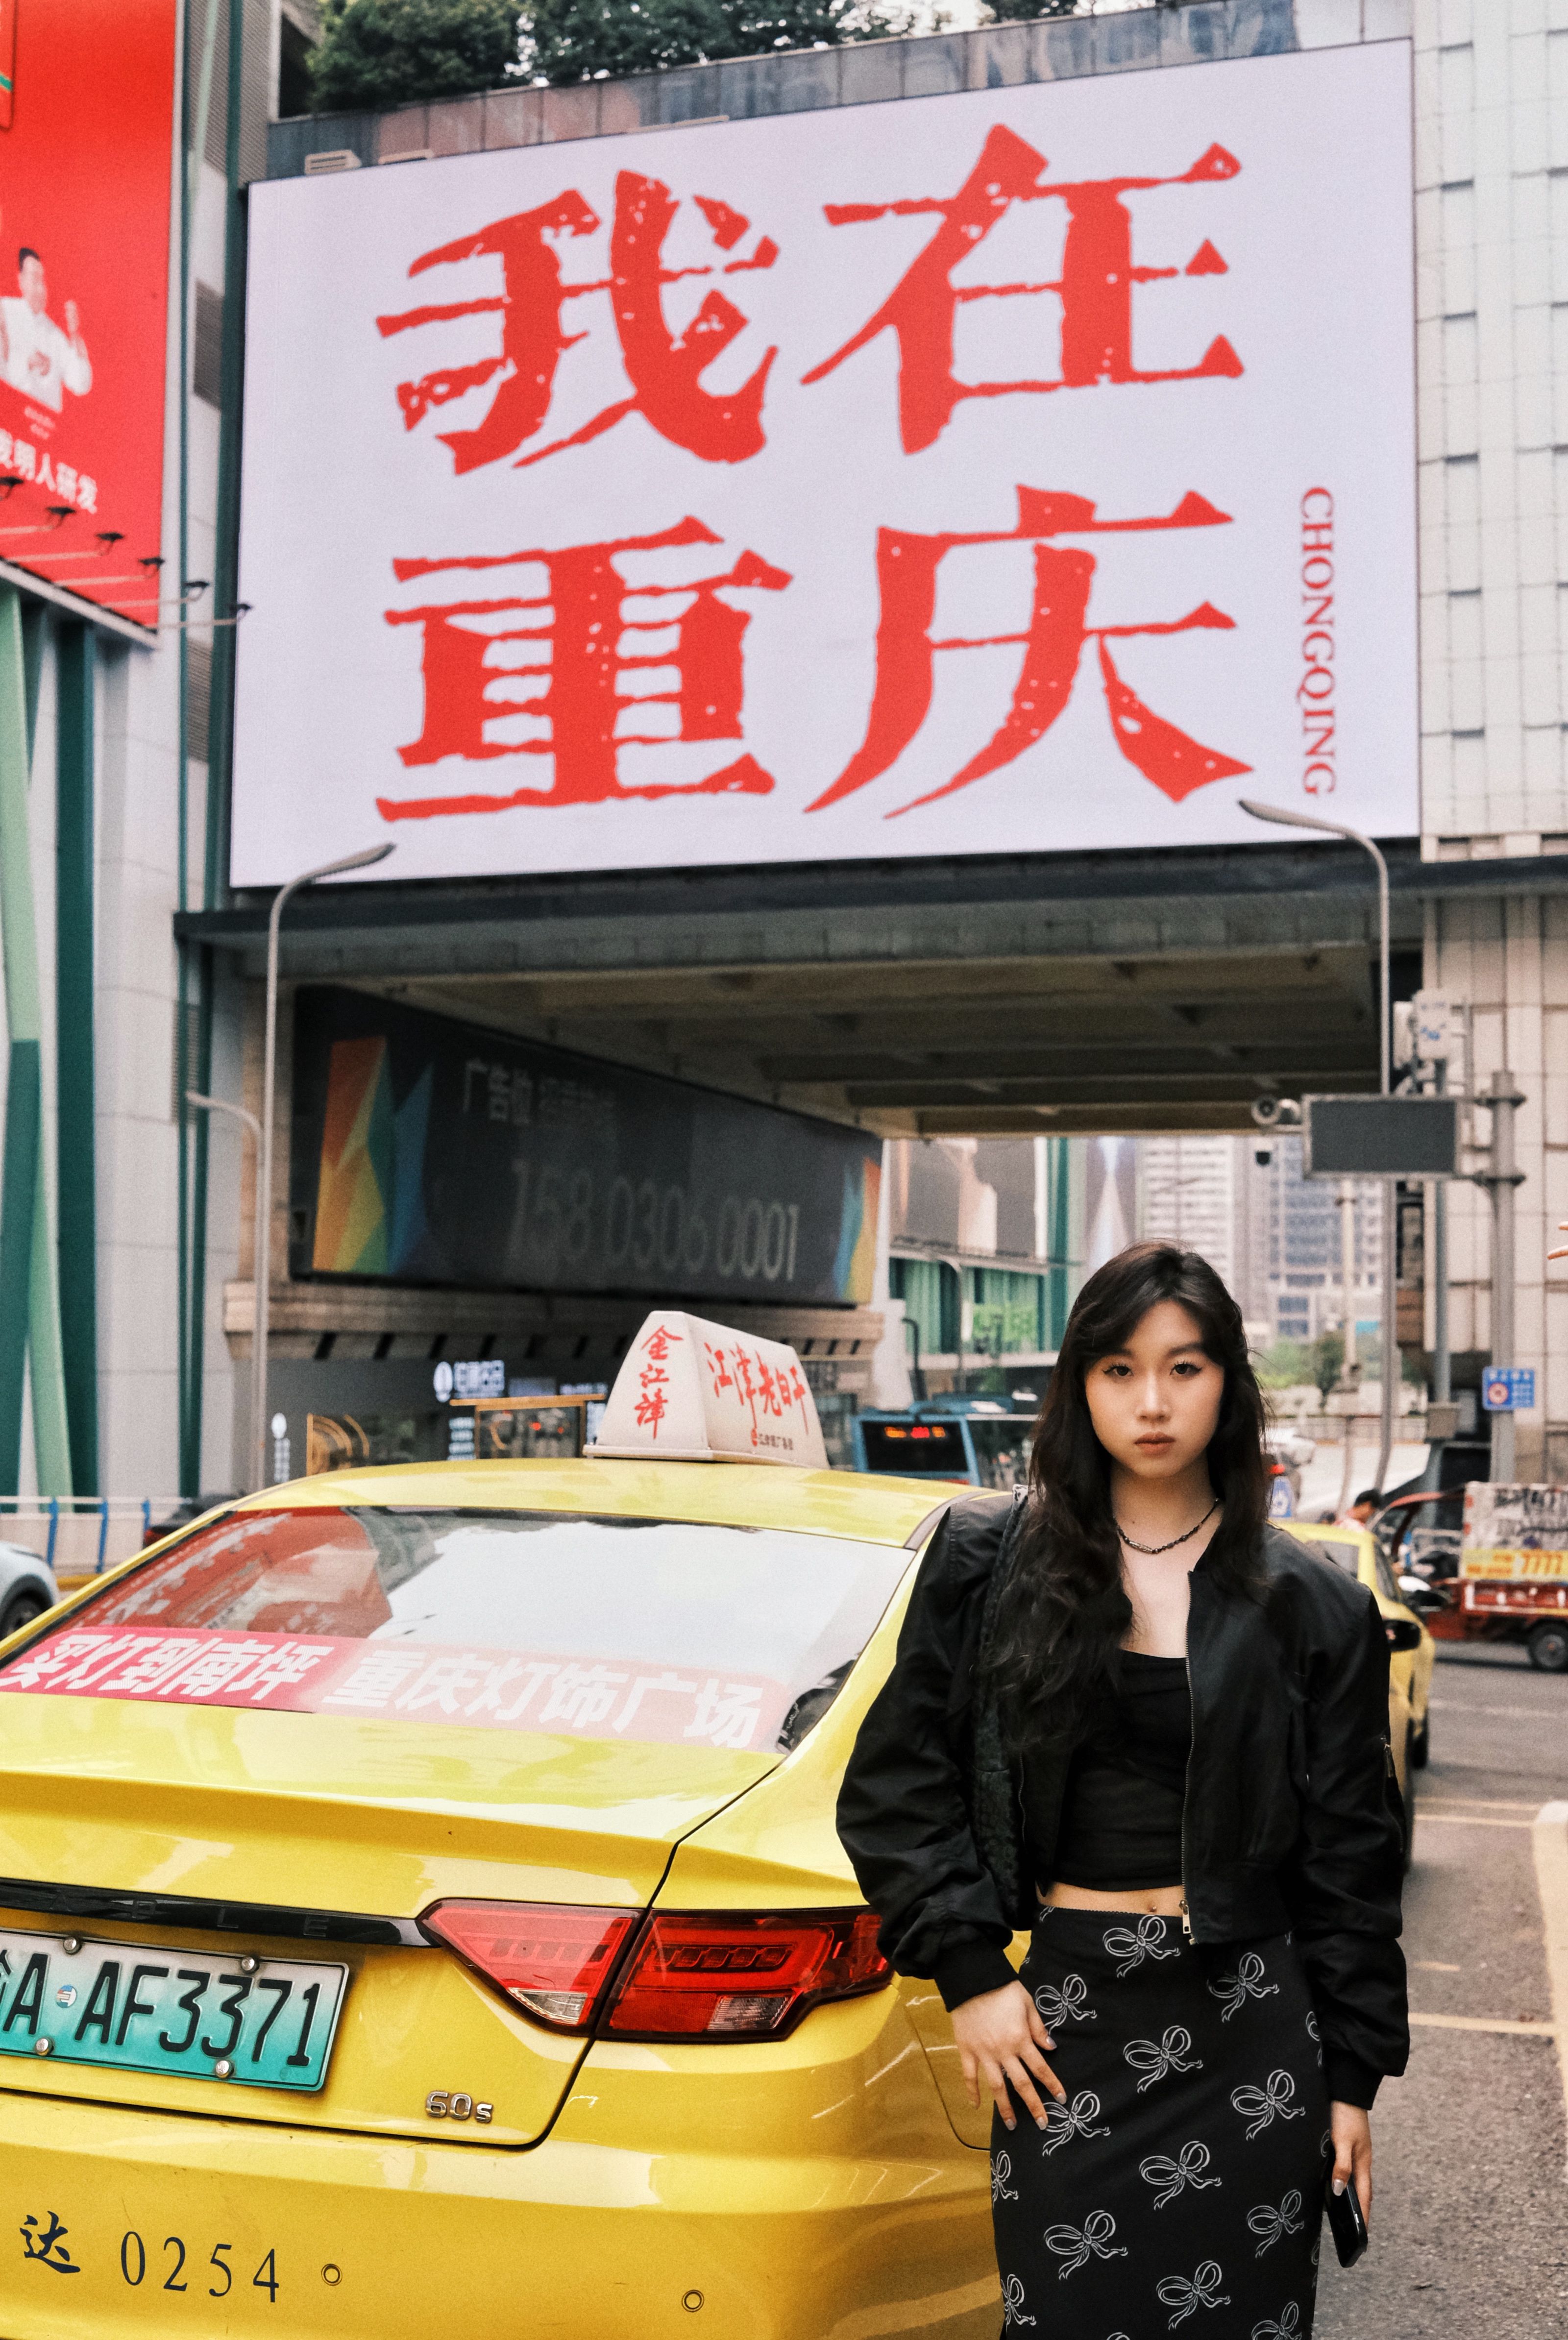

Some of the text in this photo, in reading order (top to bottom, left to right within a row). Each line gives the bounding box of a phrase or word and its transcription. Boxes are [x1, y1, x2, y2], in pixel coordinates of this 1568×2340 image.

[376, 123, 1245, 475] 我在
[376, 484, 1254, 822] 重庆
[1296, 486, 1336, 795] CHONGQING
[716, 1194, 800, 1282] 0001
[704, 1341, 809, 1435] 江津老白干
[0, 1633, 763, 1750] 买灯到南坪 重庆灯饰广场
[74, 1961, 320, 2067] AF3371
[425, 2091, 493, 2123] 60s
[20, 2211, 279, 2303] 达 0254
